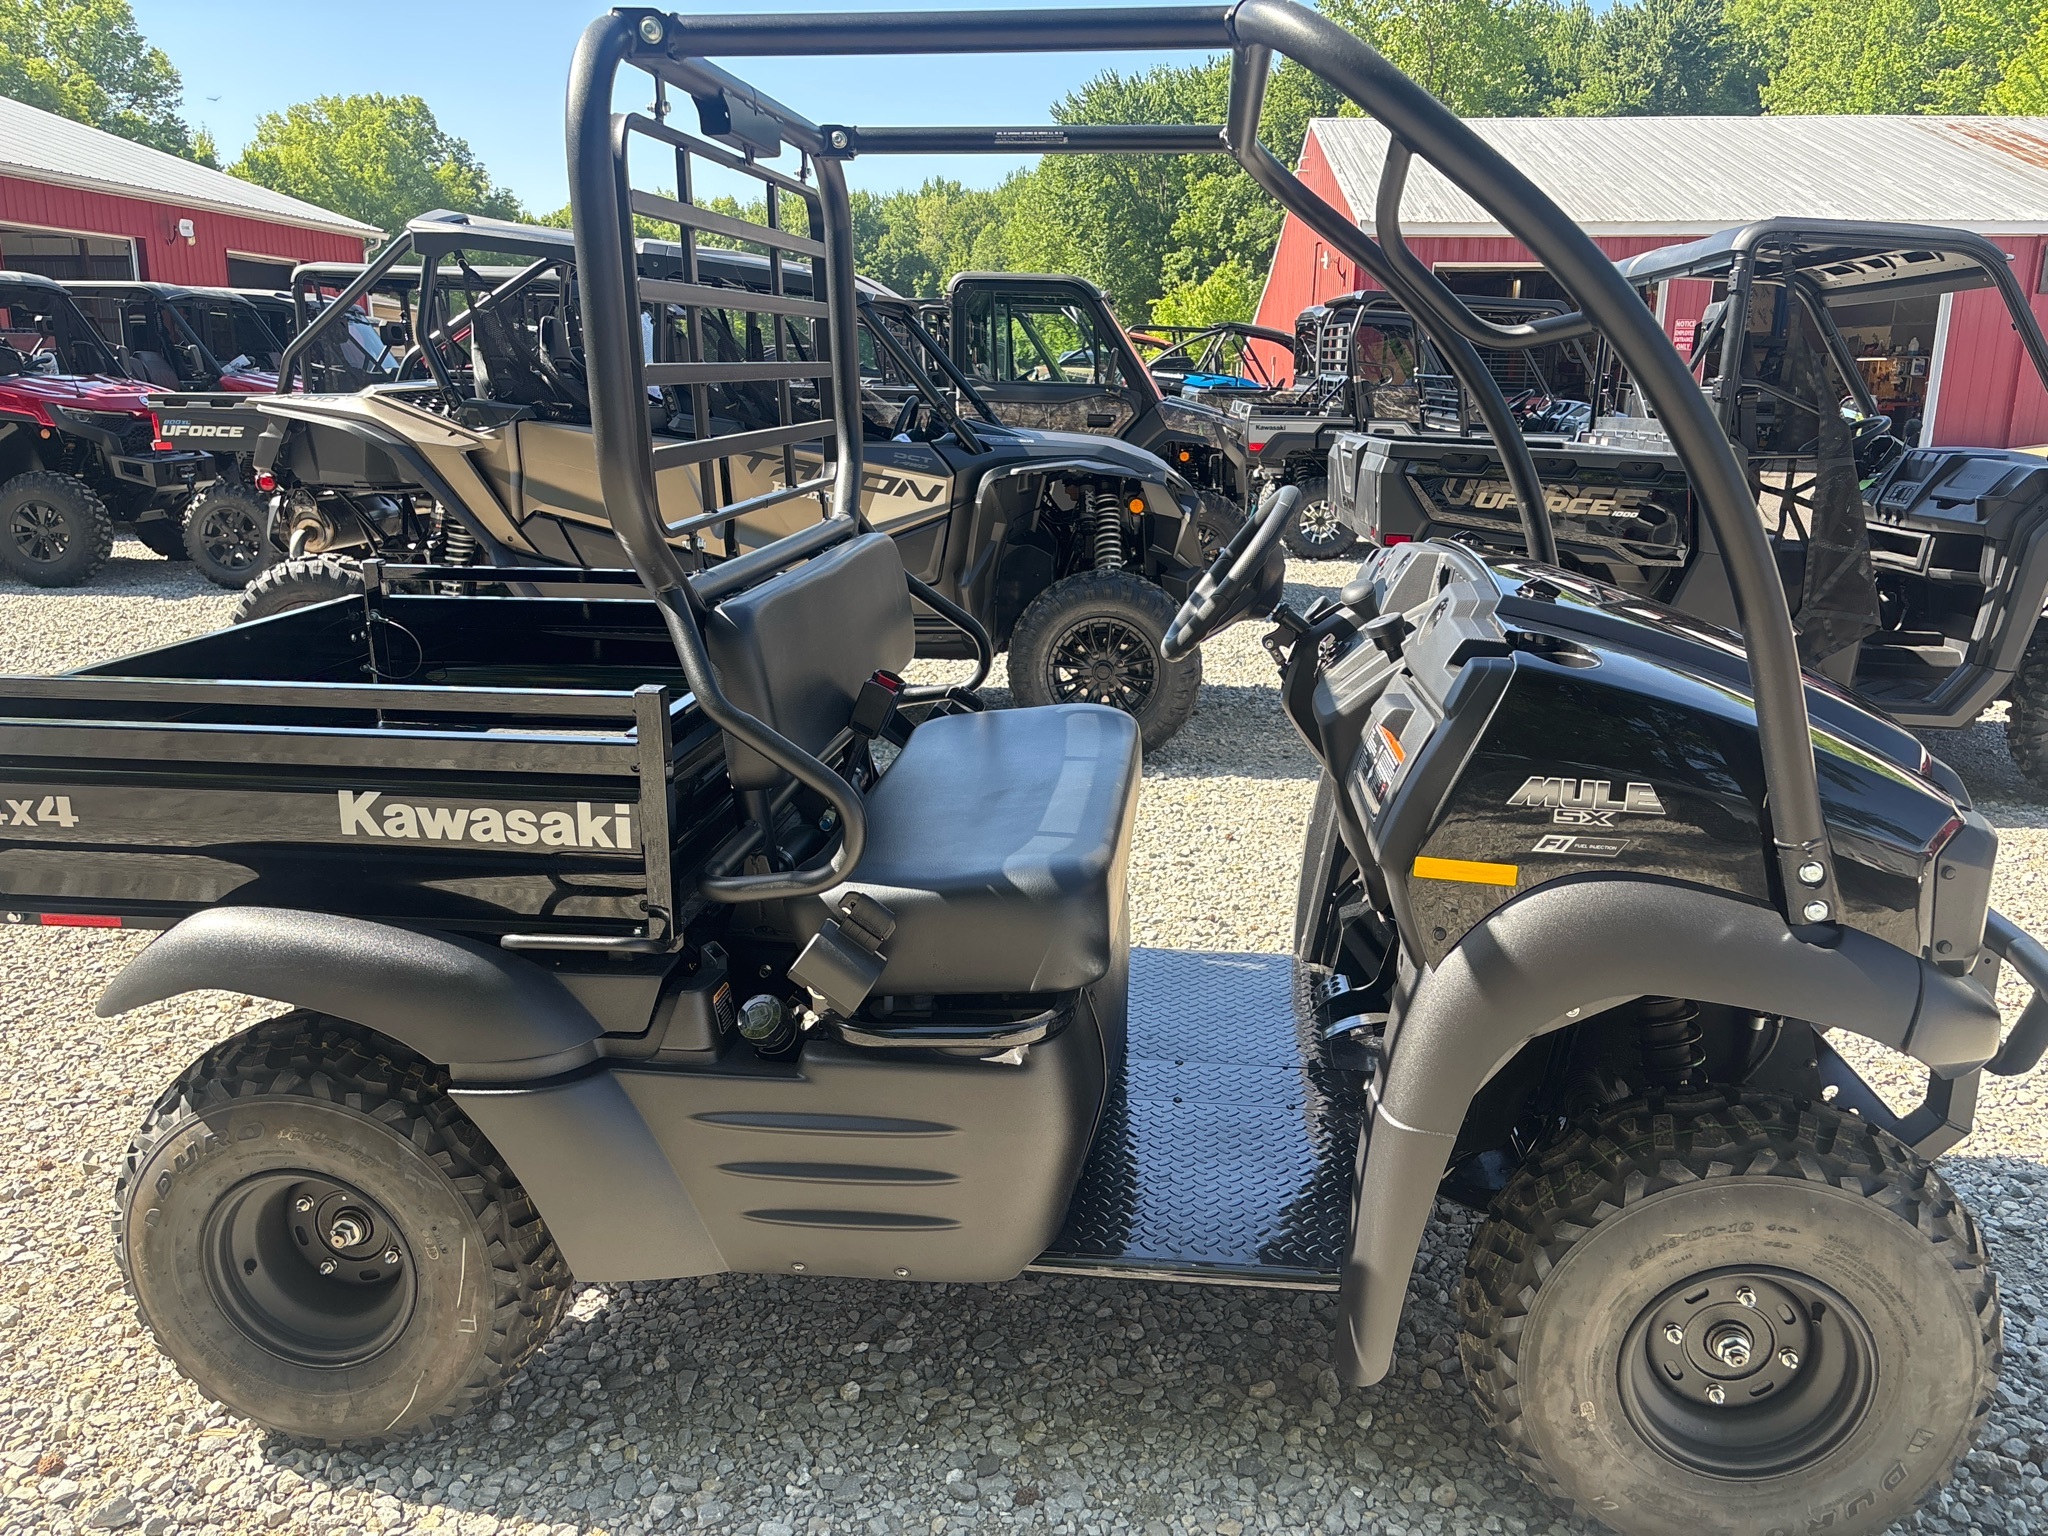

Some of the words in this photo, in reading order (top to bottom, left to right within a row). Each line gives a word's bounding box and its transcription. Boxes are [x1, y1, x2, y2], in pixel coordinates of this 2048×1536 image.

[161, 425, 245, 438] UFORCE
[893, 451, 933, 464] DCT
[1474, 492, 1617, 517] UFRCE
[1611, 510, 1639, 519] 1000
[1505, 775, 1667, 816] MULE
[337, 789, 632, 850] Kawasaki
[1553, 808, 1617, 828] SX
[1538, 837, 1570, 849] FI
